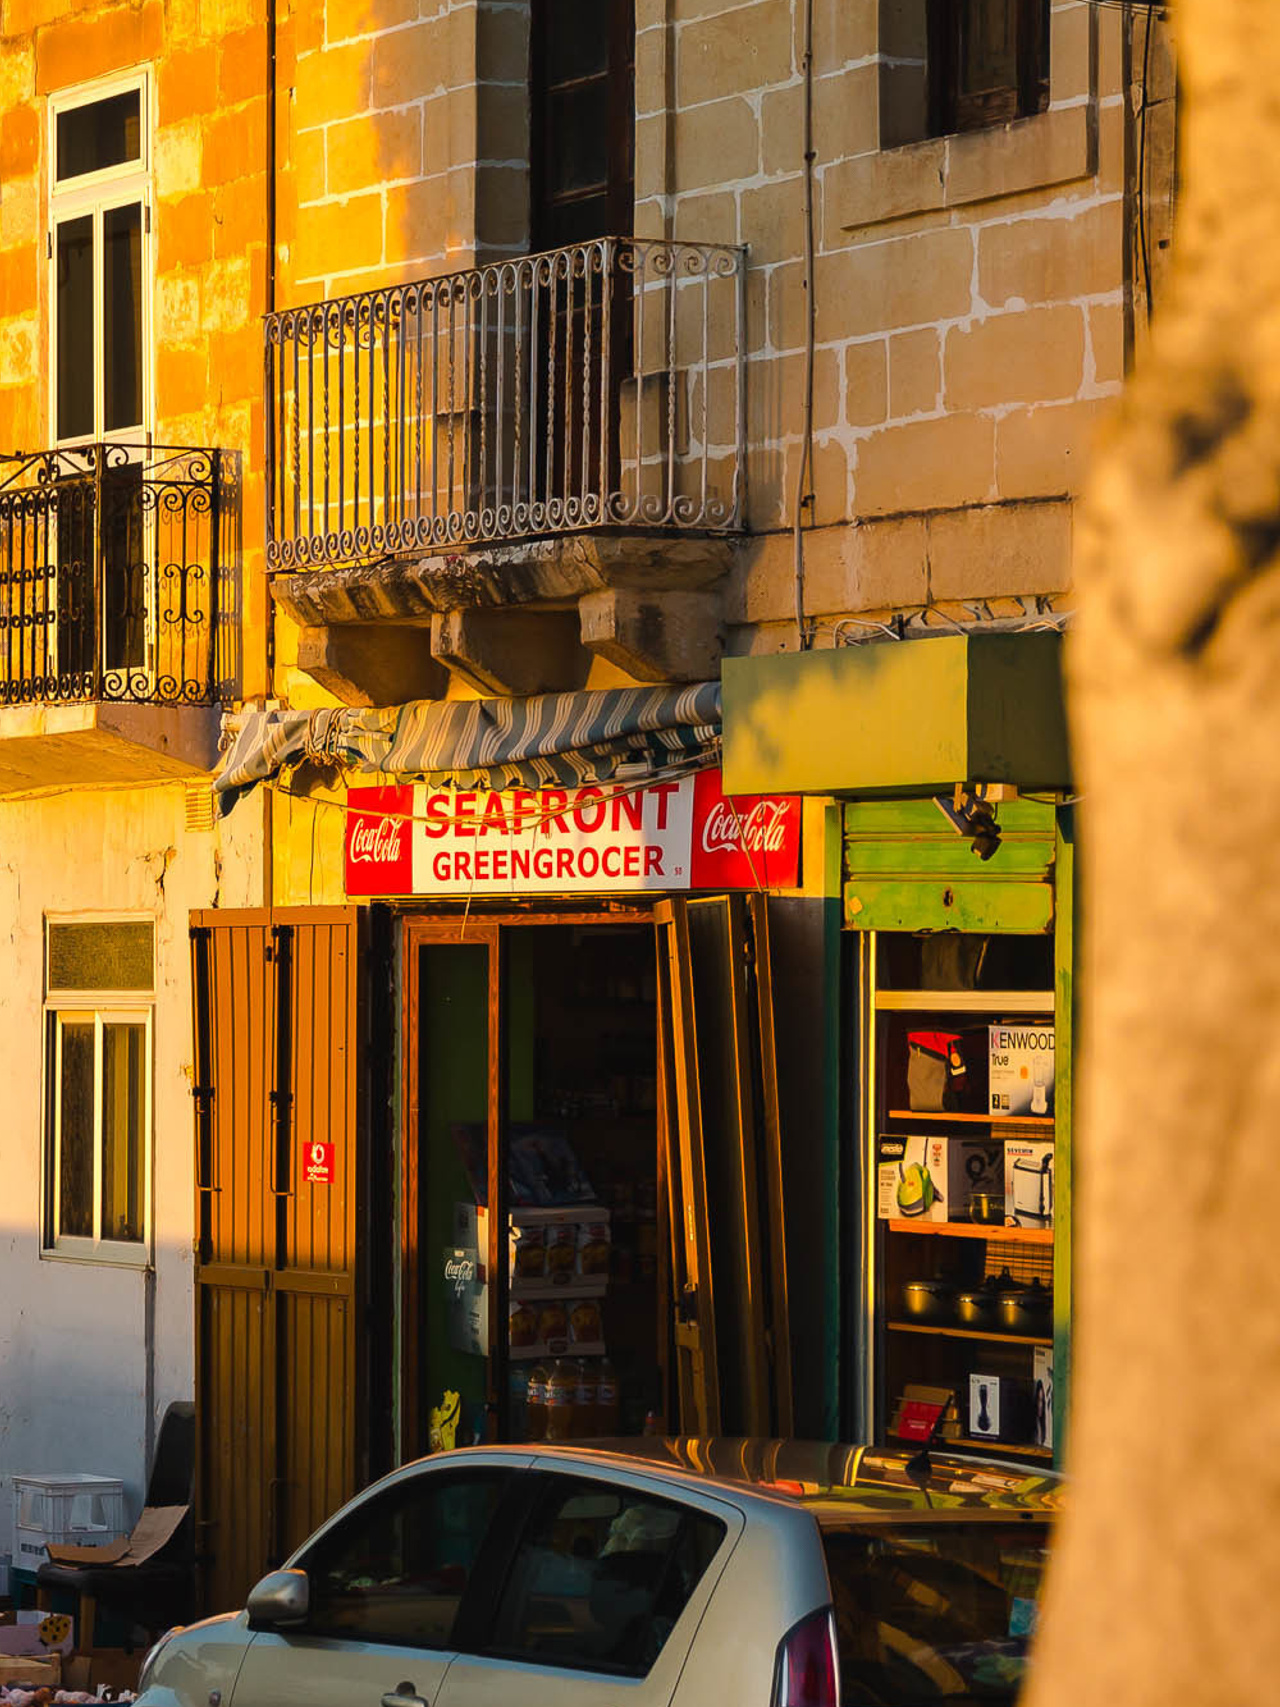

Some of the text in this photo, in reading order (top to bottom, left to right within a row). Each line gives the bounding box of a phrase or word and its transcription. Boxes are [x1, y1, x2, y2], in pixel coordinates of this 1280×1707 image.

[424, 783, 681, 838] SEAFRONT
[702, 800, 791, 855] Coca-Cola
[350, 815, 402, 864] Coca-Cola
[432, 845, 665, 881] GREENGROCER
[991, 1031, 1056, 1051] KENWOOD
